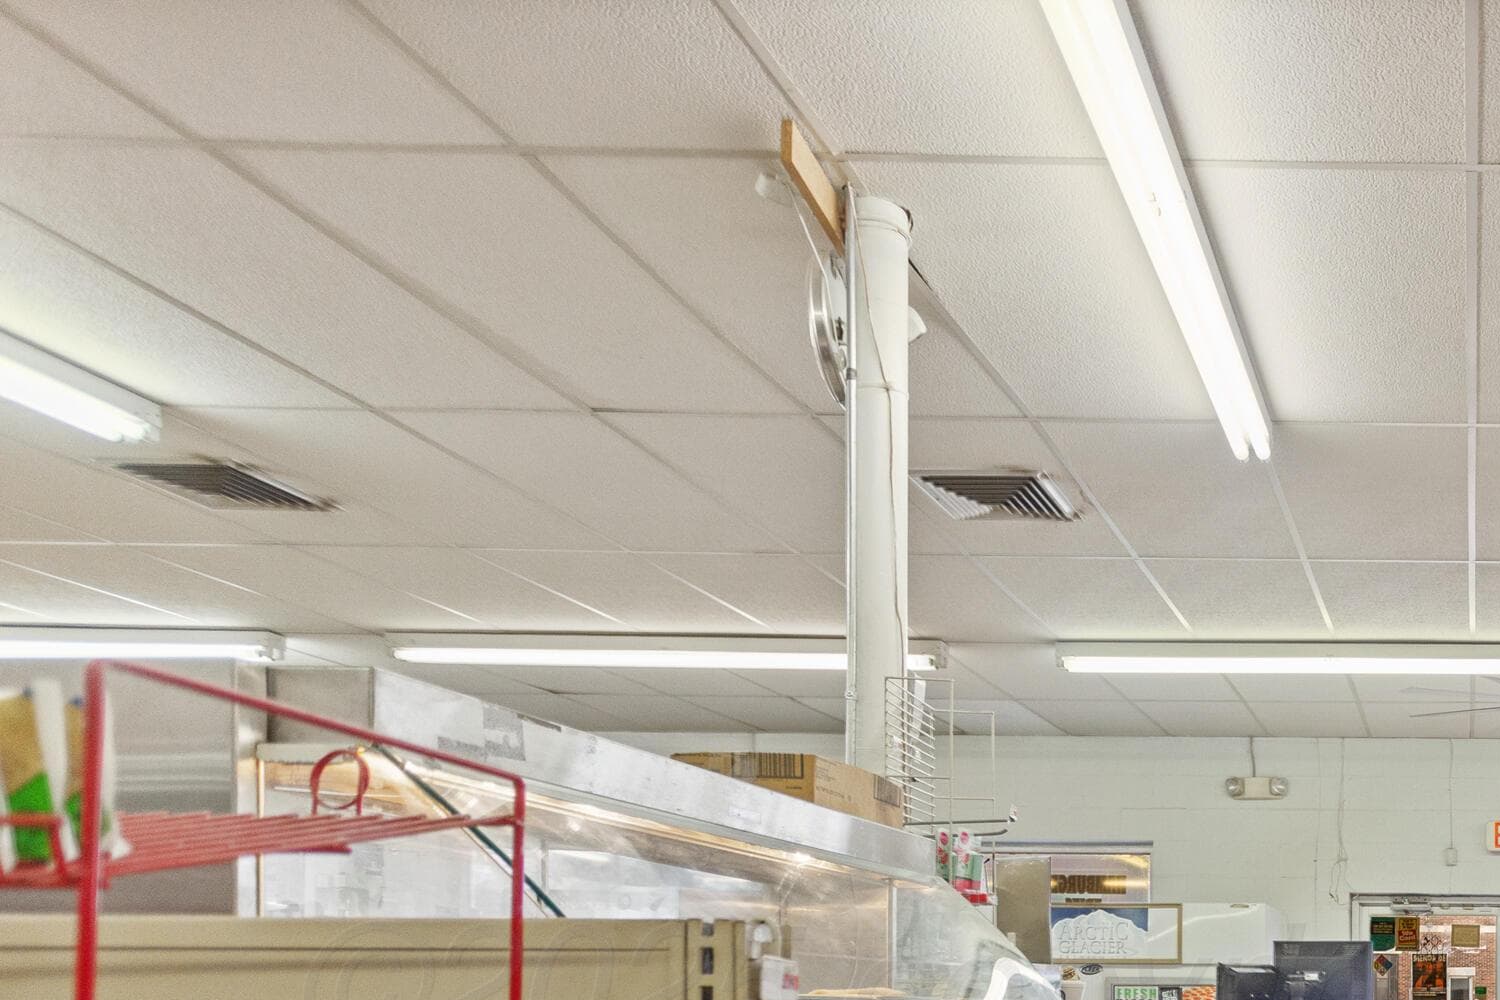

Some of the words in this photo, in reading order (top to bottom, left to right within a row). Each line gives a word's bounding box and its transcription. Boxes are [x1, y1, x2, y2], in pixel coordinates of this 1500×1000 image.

[1058, 921, 1130, 942] ARCTIC
[1058, 940, 1128, 955] GLACIER
[1116, 987, 1158, 999] FRESH
